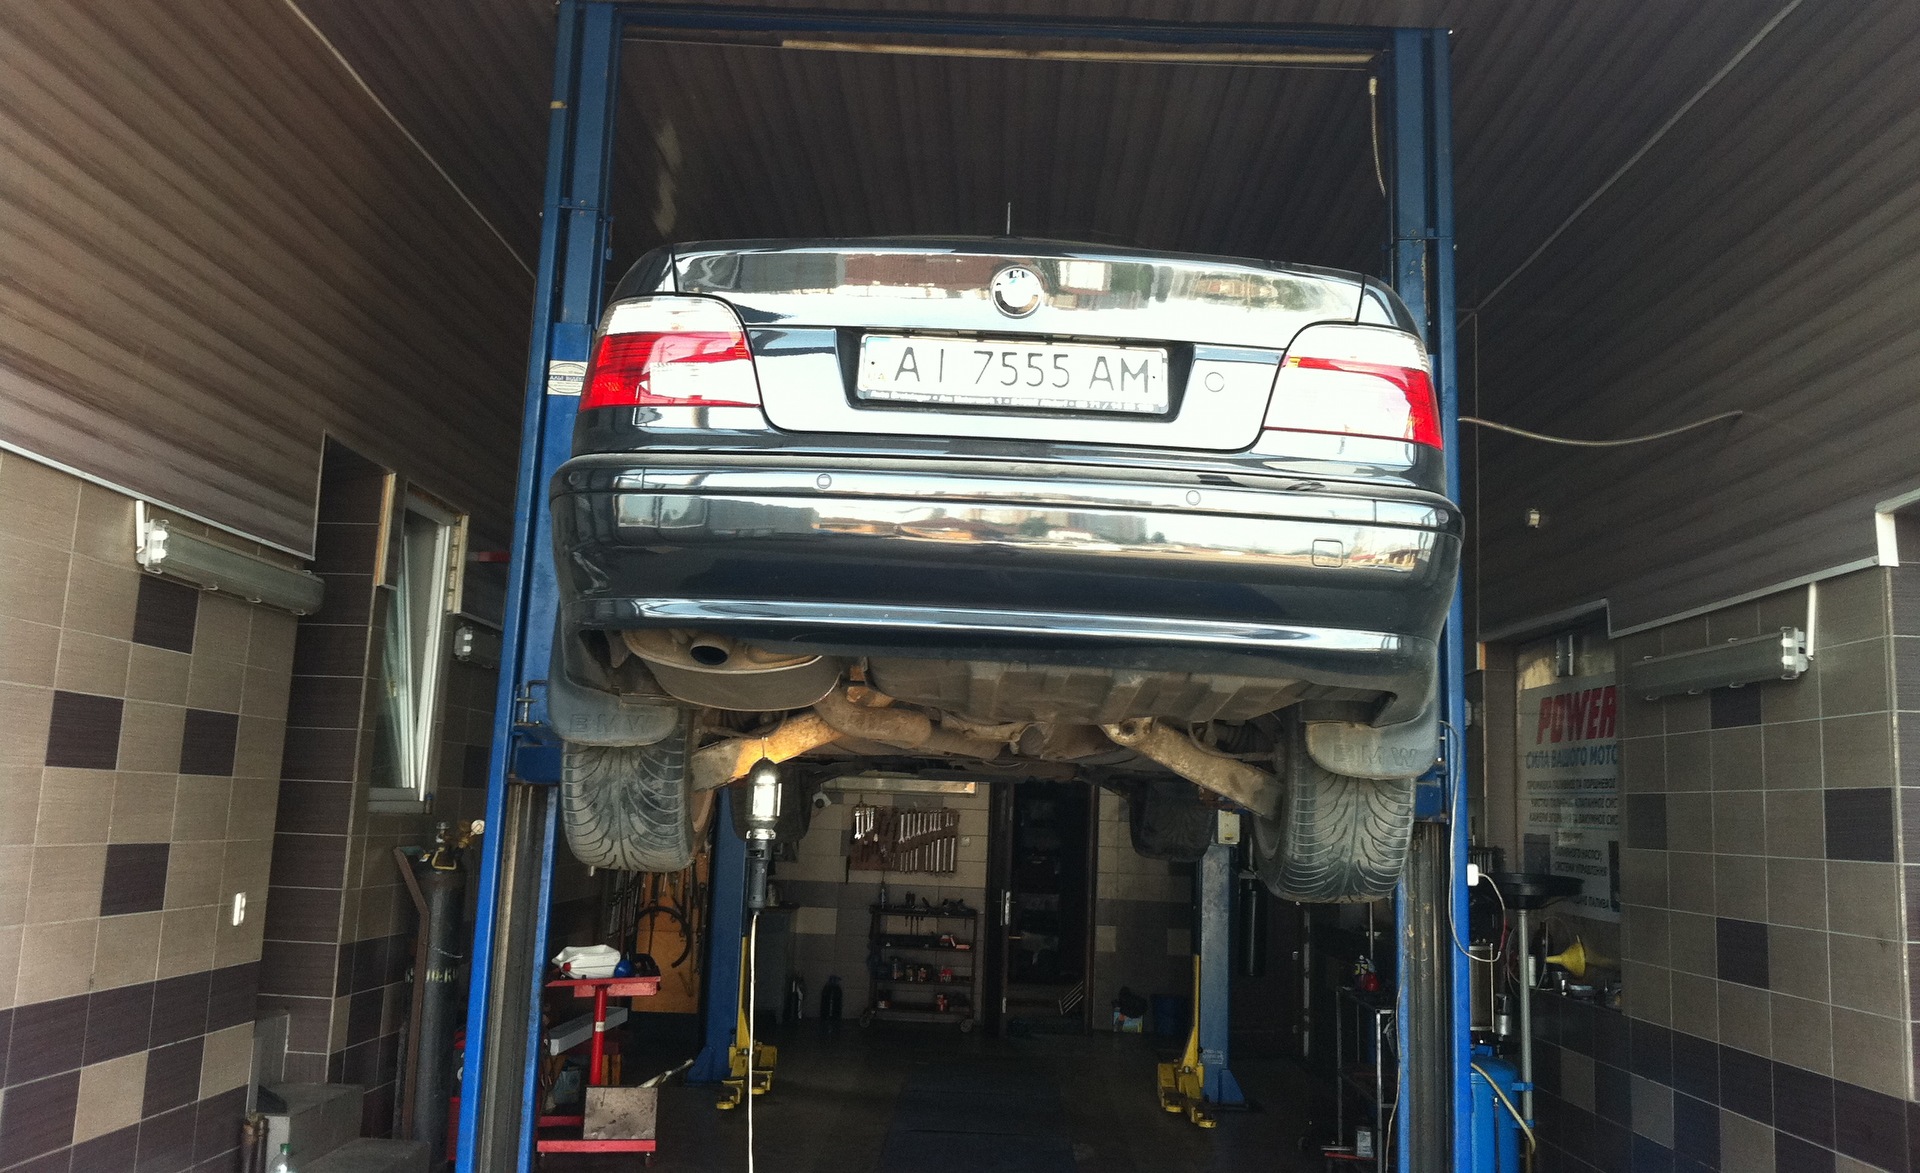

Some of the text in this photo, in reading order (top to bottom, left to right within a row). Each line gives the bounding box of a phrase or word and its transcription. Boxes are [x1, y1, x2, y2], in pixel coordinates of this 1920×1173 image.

[974, 350, 1070, 388] 7555
[1089, 355, 1149, 393] AM
[1536, 684, 1617, 745] POWER
[1333, 743, 1417, 768] BMW
[1552, 746, 1588, 768] ВАШОГО
